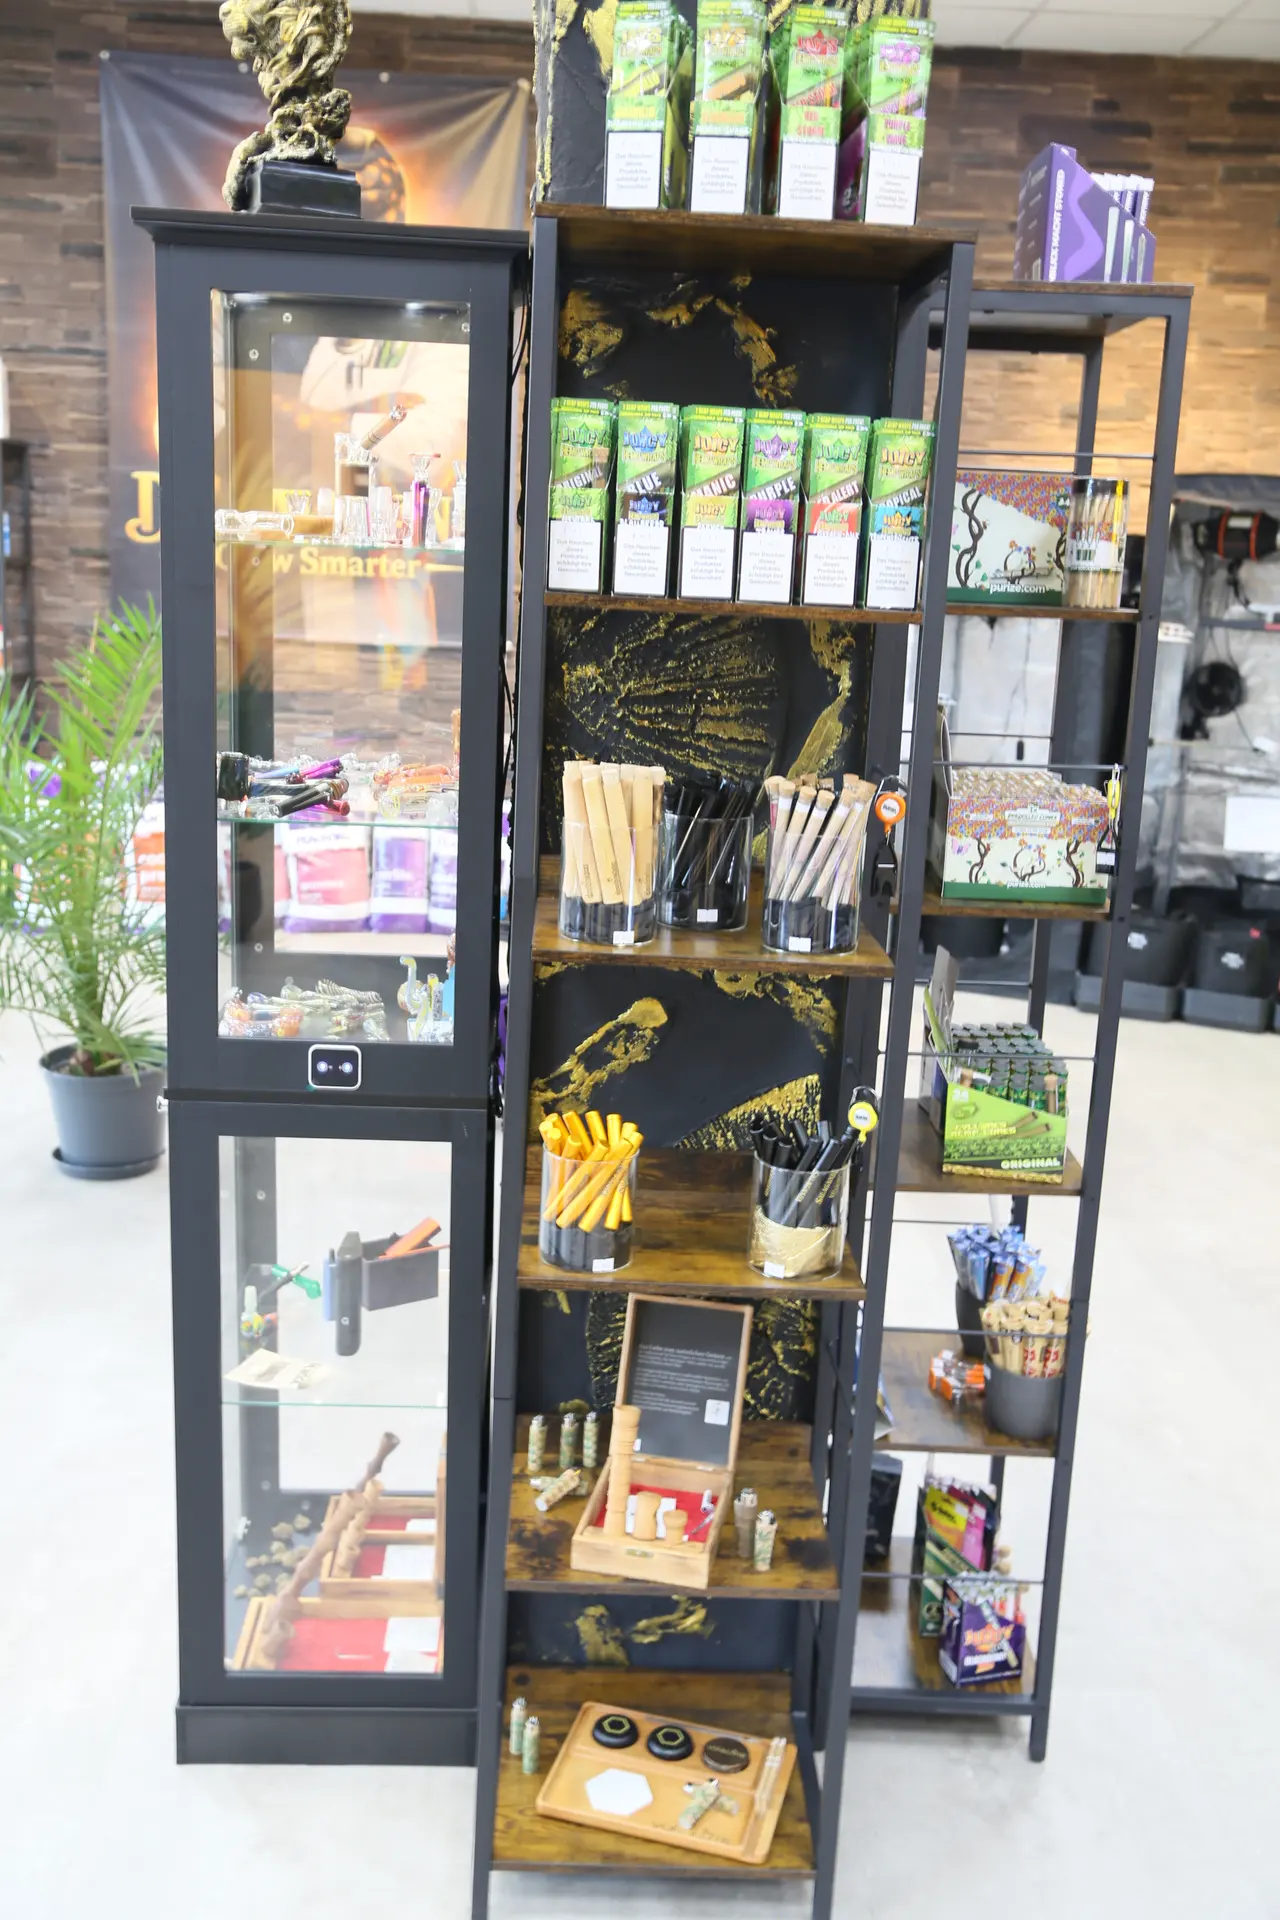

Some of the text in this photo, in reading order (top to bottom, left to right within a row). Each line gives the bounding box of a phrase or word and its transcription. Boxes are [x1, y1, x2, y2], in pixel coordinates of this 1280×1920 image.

[562, 425, 606, 446] JUICY
[623, 430, 669, 449] JUICY
[694, 434, 740, 453] JUICY
[754, 438, 799, 457] JUICY
[816, 443, 861, 461] JUICY
[880, 447, 926, 466] JUICY
[300, 547, 422, 578] Smarter
[989, 582, 1046, 595] purize.com
[1001, 1157, 1061, 1170] ORIGINAL
